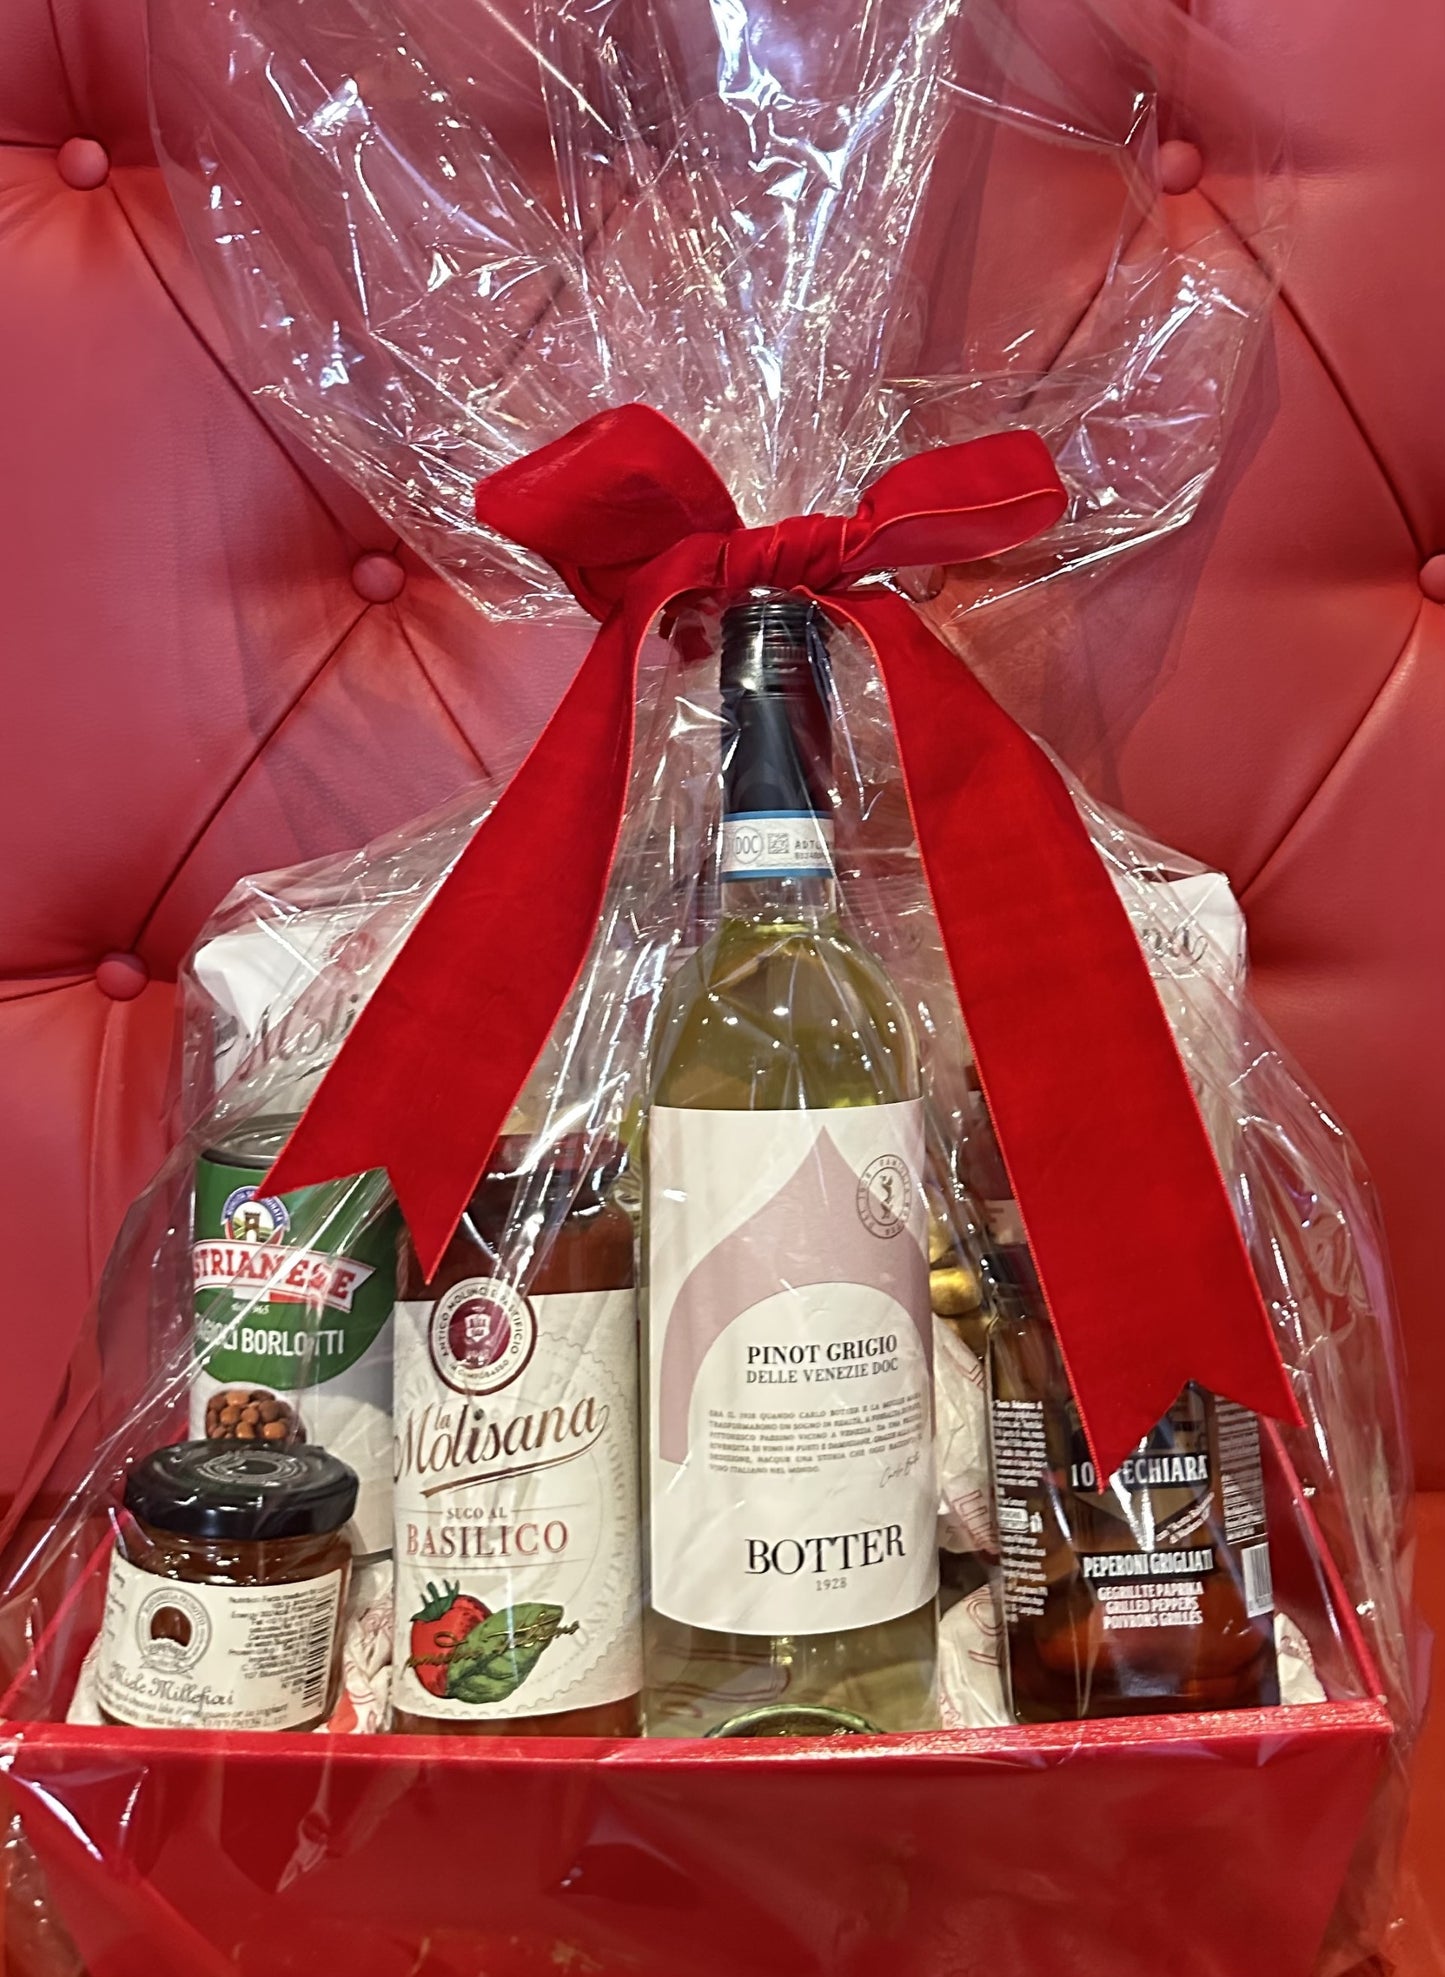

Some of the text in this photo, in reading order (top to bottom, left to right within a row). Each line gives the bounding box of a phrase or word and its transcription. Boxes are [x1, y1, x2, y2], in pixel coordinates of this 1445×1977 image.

[448, 1286, 489, 1309] MOLINO
[241, 1327, 345, 1357] BORLOTTI
[747, 1334, 898, 1365] PINOT GRIGIO
[746, 1357, 899, 1384] DELLE VENEZIE DOC
[435, 1405, 451, 1430] la
[393, 1396, 609, 1484] Molisana
[488, 1505, 508, 1519] AL
[406, 1520, 569, 1558] BASILICO
[744, 1523, 906, 1576] BOTTER
[1083, 1553, 1149, 1578] PEPERONI
[816, 1576, 848, 1592] 1928
[1151, 1596, 1199, 1612] PEPPERS
